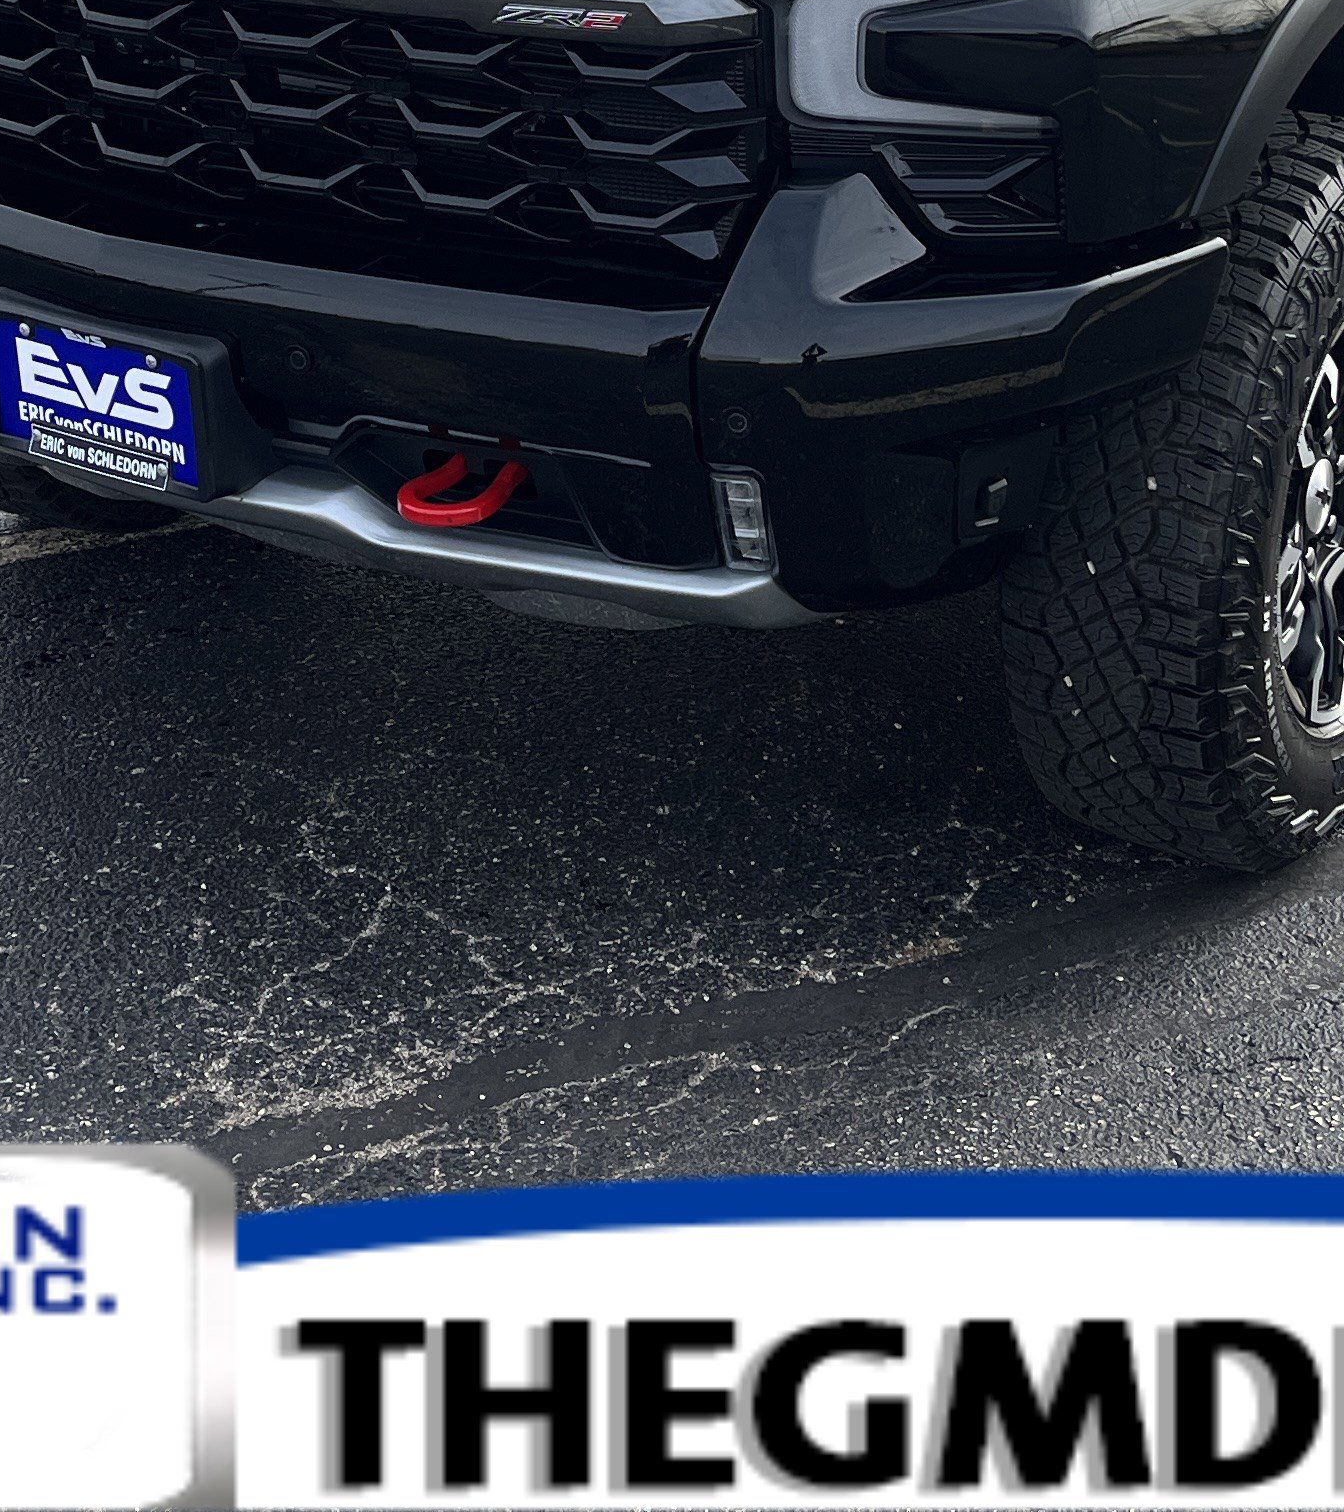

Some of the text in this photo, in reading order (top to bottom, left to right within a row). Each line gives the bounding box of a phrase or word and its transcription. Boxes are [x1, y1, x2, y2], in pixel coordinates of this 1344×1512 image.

[492, 3, 632, 31] ZR2
[40, 435, 158, 481] ERIC von SCHLEDORN
